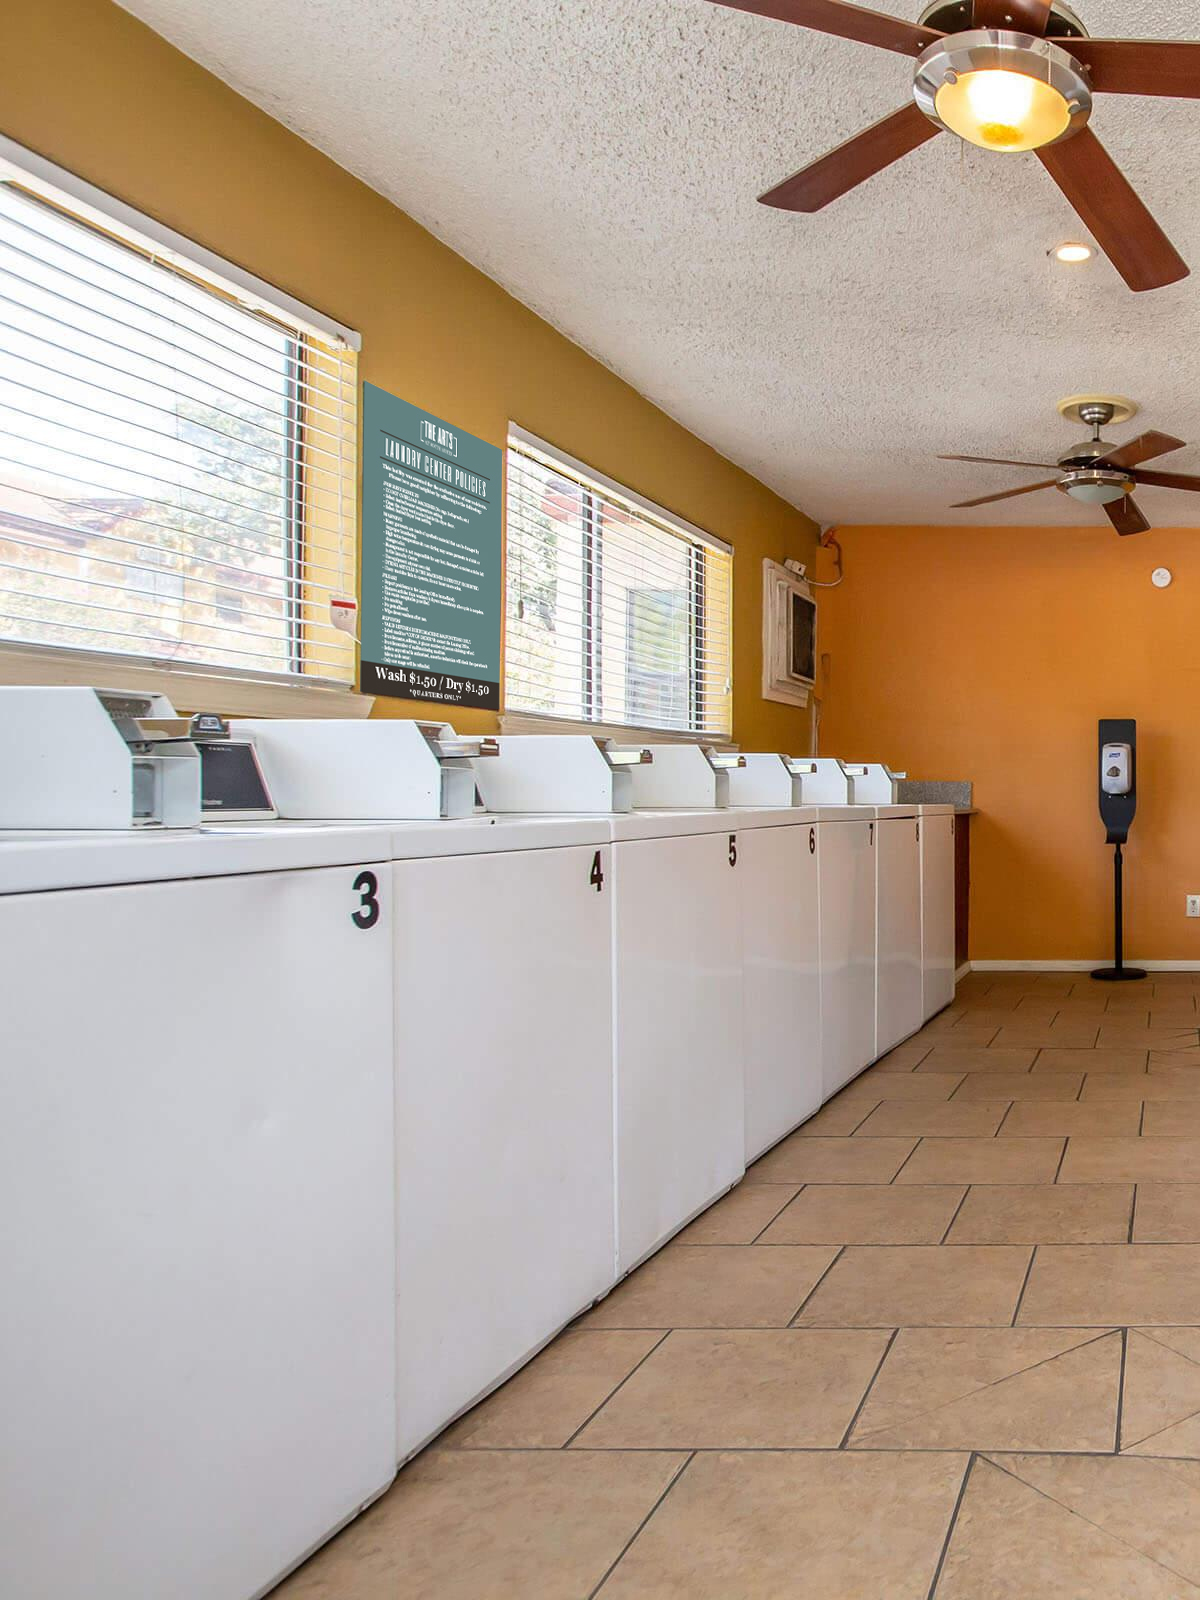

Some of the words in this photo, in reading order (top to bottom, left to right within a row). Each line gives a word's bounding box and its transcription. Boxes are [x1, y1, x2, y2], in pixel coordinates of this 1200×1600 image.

[424, 420, 436, 442] THE
[437, 427, 453, 450] ARTS
[385, 438, 421, 469] LAUNDRY
[424, 455, 452, 483] CENTER
[455, 469, 486, 497] POLICIES
[375, 666, 407, 683] Wash
[409, 671, 437, 689] $1.50
[446, 678, 464, 694] Dry
[465, 681, 490, 696] $1.50
[809, 827, 816, 855] 6
[868, 823, 874, 846] 7
[727, 834, 737, 867] 5
[588, 850, 605, 892] 4
[352, 871, 380, 930] 3
